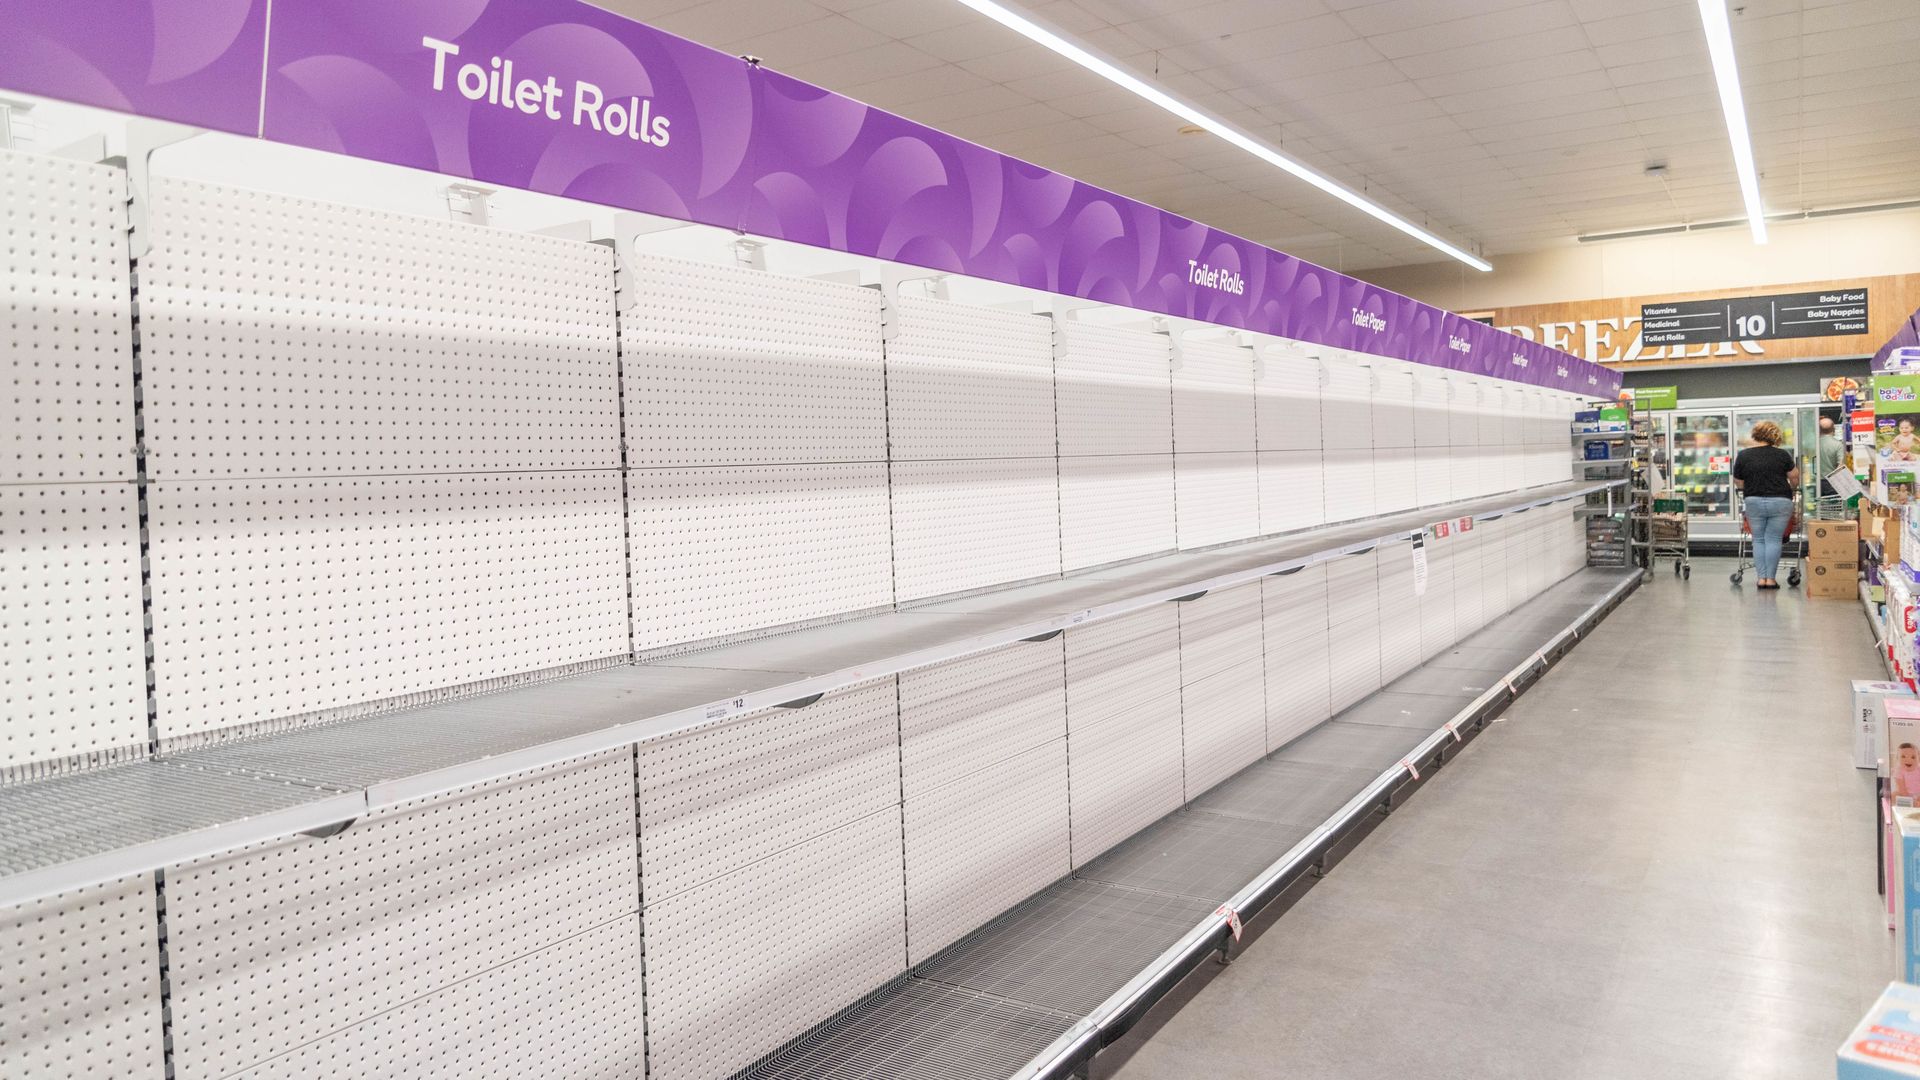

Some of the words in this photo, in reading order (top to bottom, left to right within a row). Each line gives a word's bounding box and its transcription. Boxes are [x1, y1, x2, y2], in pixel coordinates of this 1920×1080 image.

[422, 36, 563, 120] Toilet
[572, 80, 671, 147] Rolls
[1188, 260, 1219, 289] Toilet
[1219, 269, 1244, 295] Rolls
[1820, 295, 1841, 303] Baby
[1842, 293, 1864, 301] Food
[1644, 307, 1677, 315] Vitamins
[1807, 310, 1829, 318] Baby
[1830, 308, 1865, 317] Nappies
[1352, 308, 1369, 328] Toilet
[1369, 312, 1386, 334] Paper
[1644, 320, 1680, 329] Medicinal
[1736, 315, 1766, 337] 10
[1666, 333, 1685, 341] Rolls
[1879, 387, 1903, 396] baby
[733, 699, 744, 708] $12
